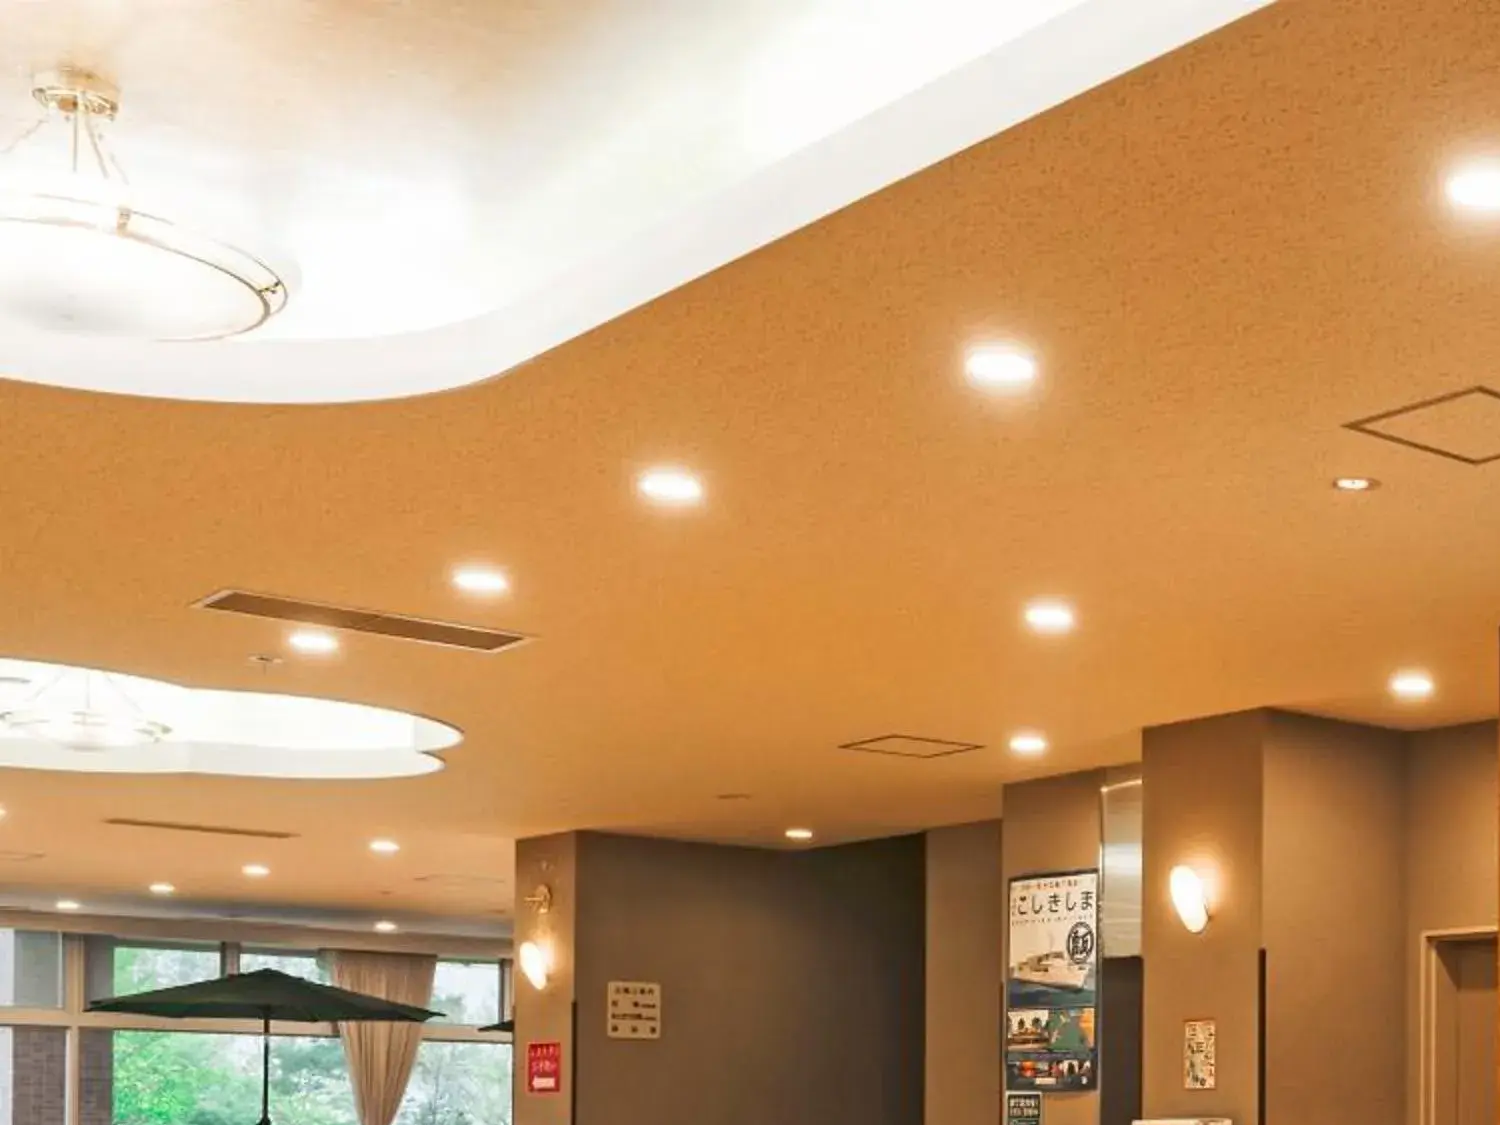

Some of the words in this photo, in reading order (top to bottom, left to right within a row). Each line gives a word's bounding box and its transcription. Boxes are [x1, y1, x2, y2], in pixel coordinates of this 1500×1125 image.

[1017, 890, 1094, 916] こしきしま
